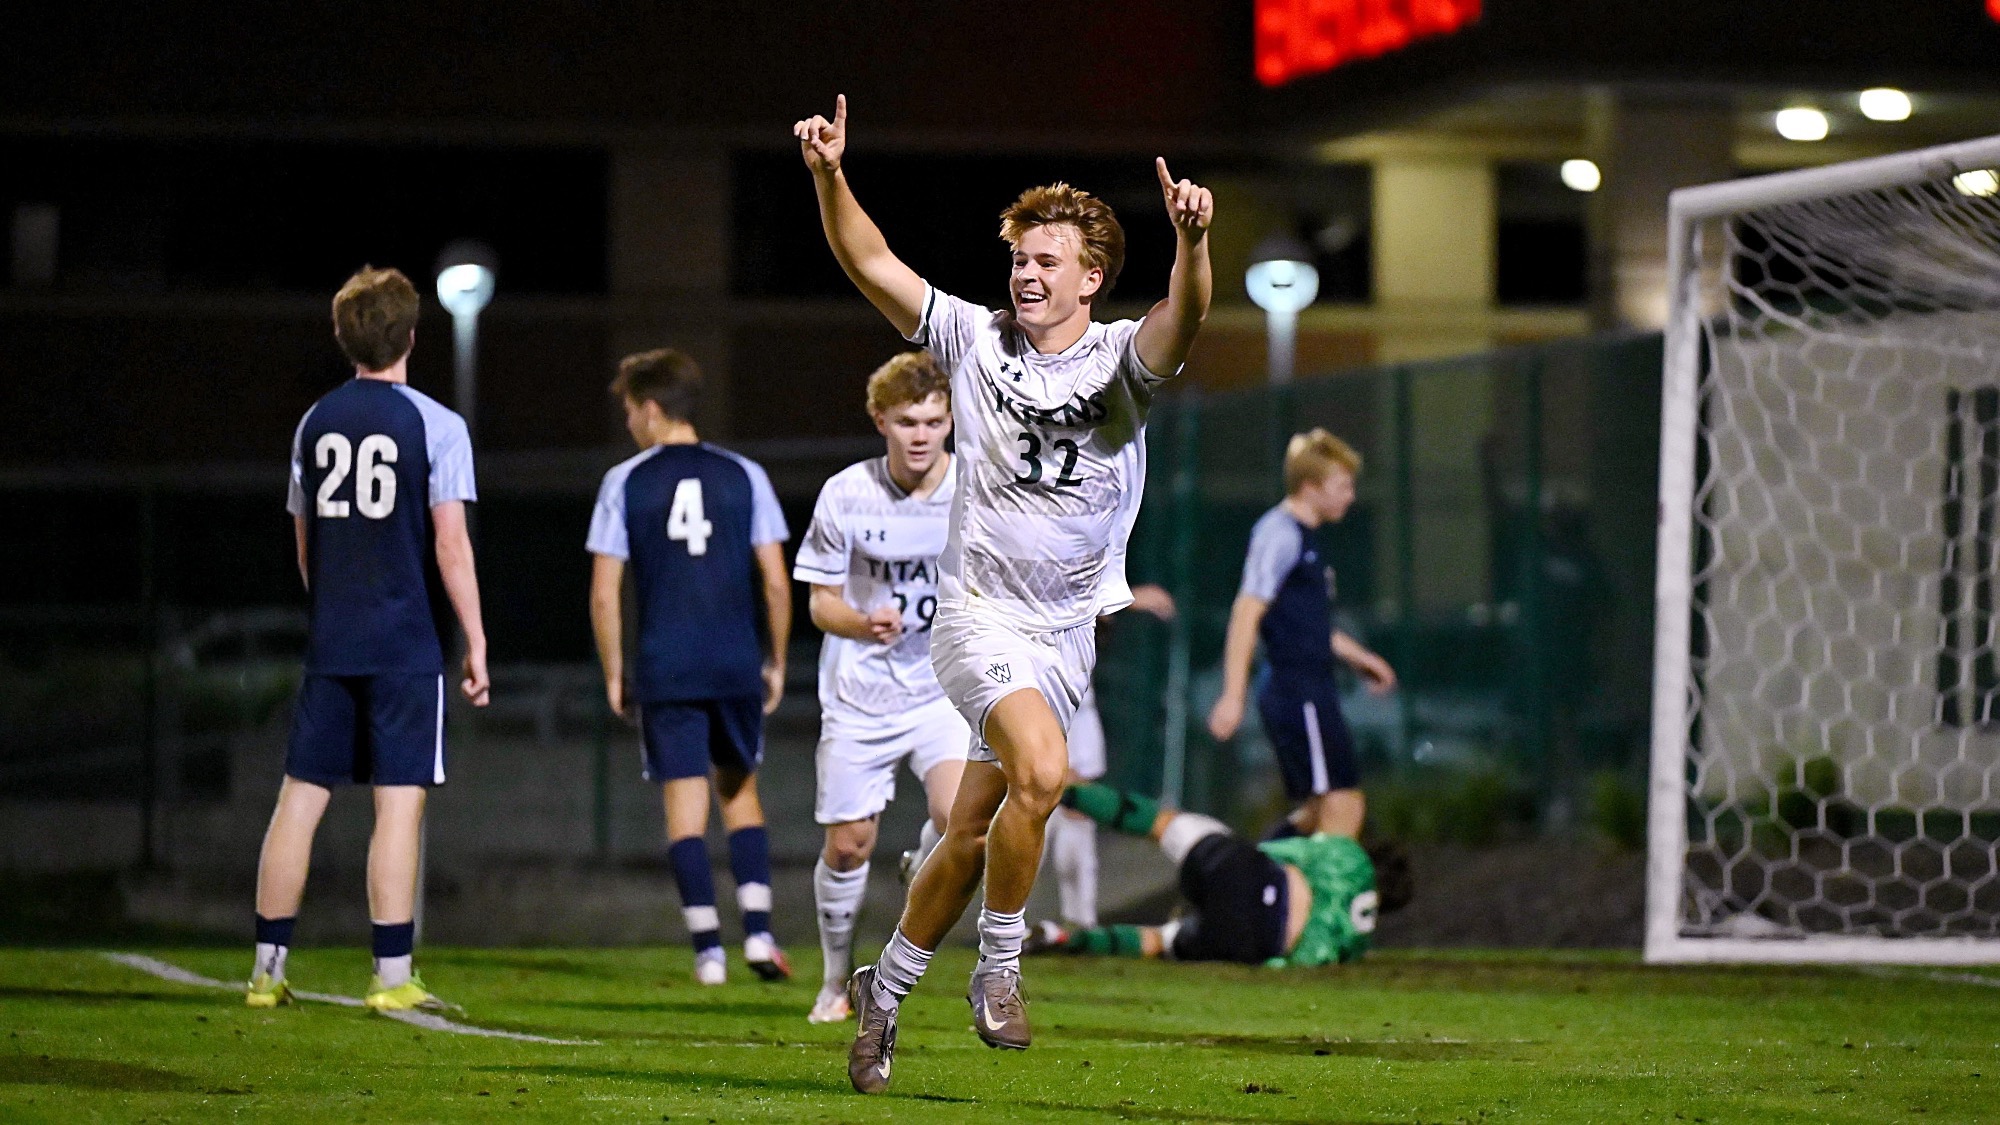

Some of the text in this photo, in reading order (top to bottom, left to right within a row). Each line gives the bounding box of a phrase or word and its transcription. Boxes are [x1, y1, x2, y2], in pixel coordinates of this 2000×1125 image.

[315, 432, 398, 519] 26
[1014, 432, 1083, 487] 32
[667, 477, 713, 556] 4
[864, 556, 939, 585] TITA
